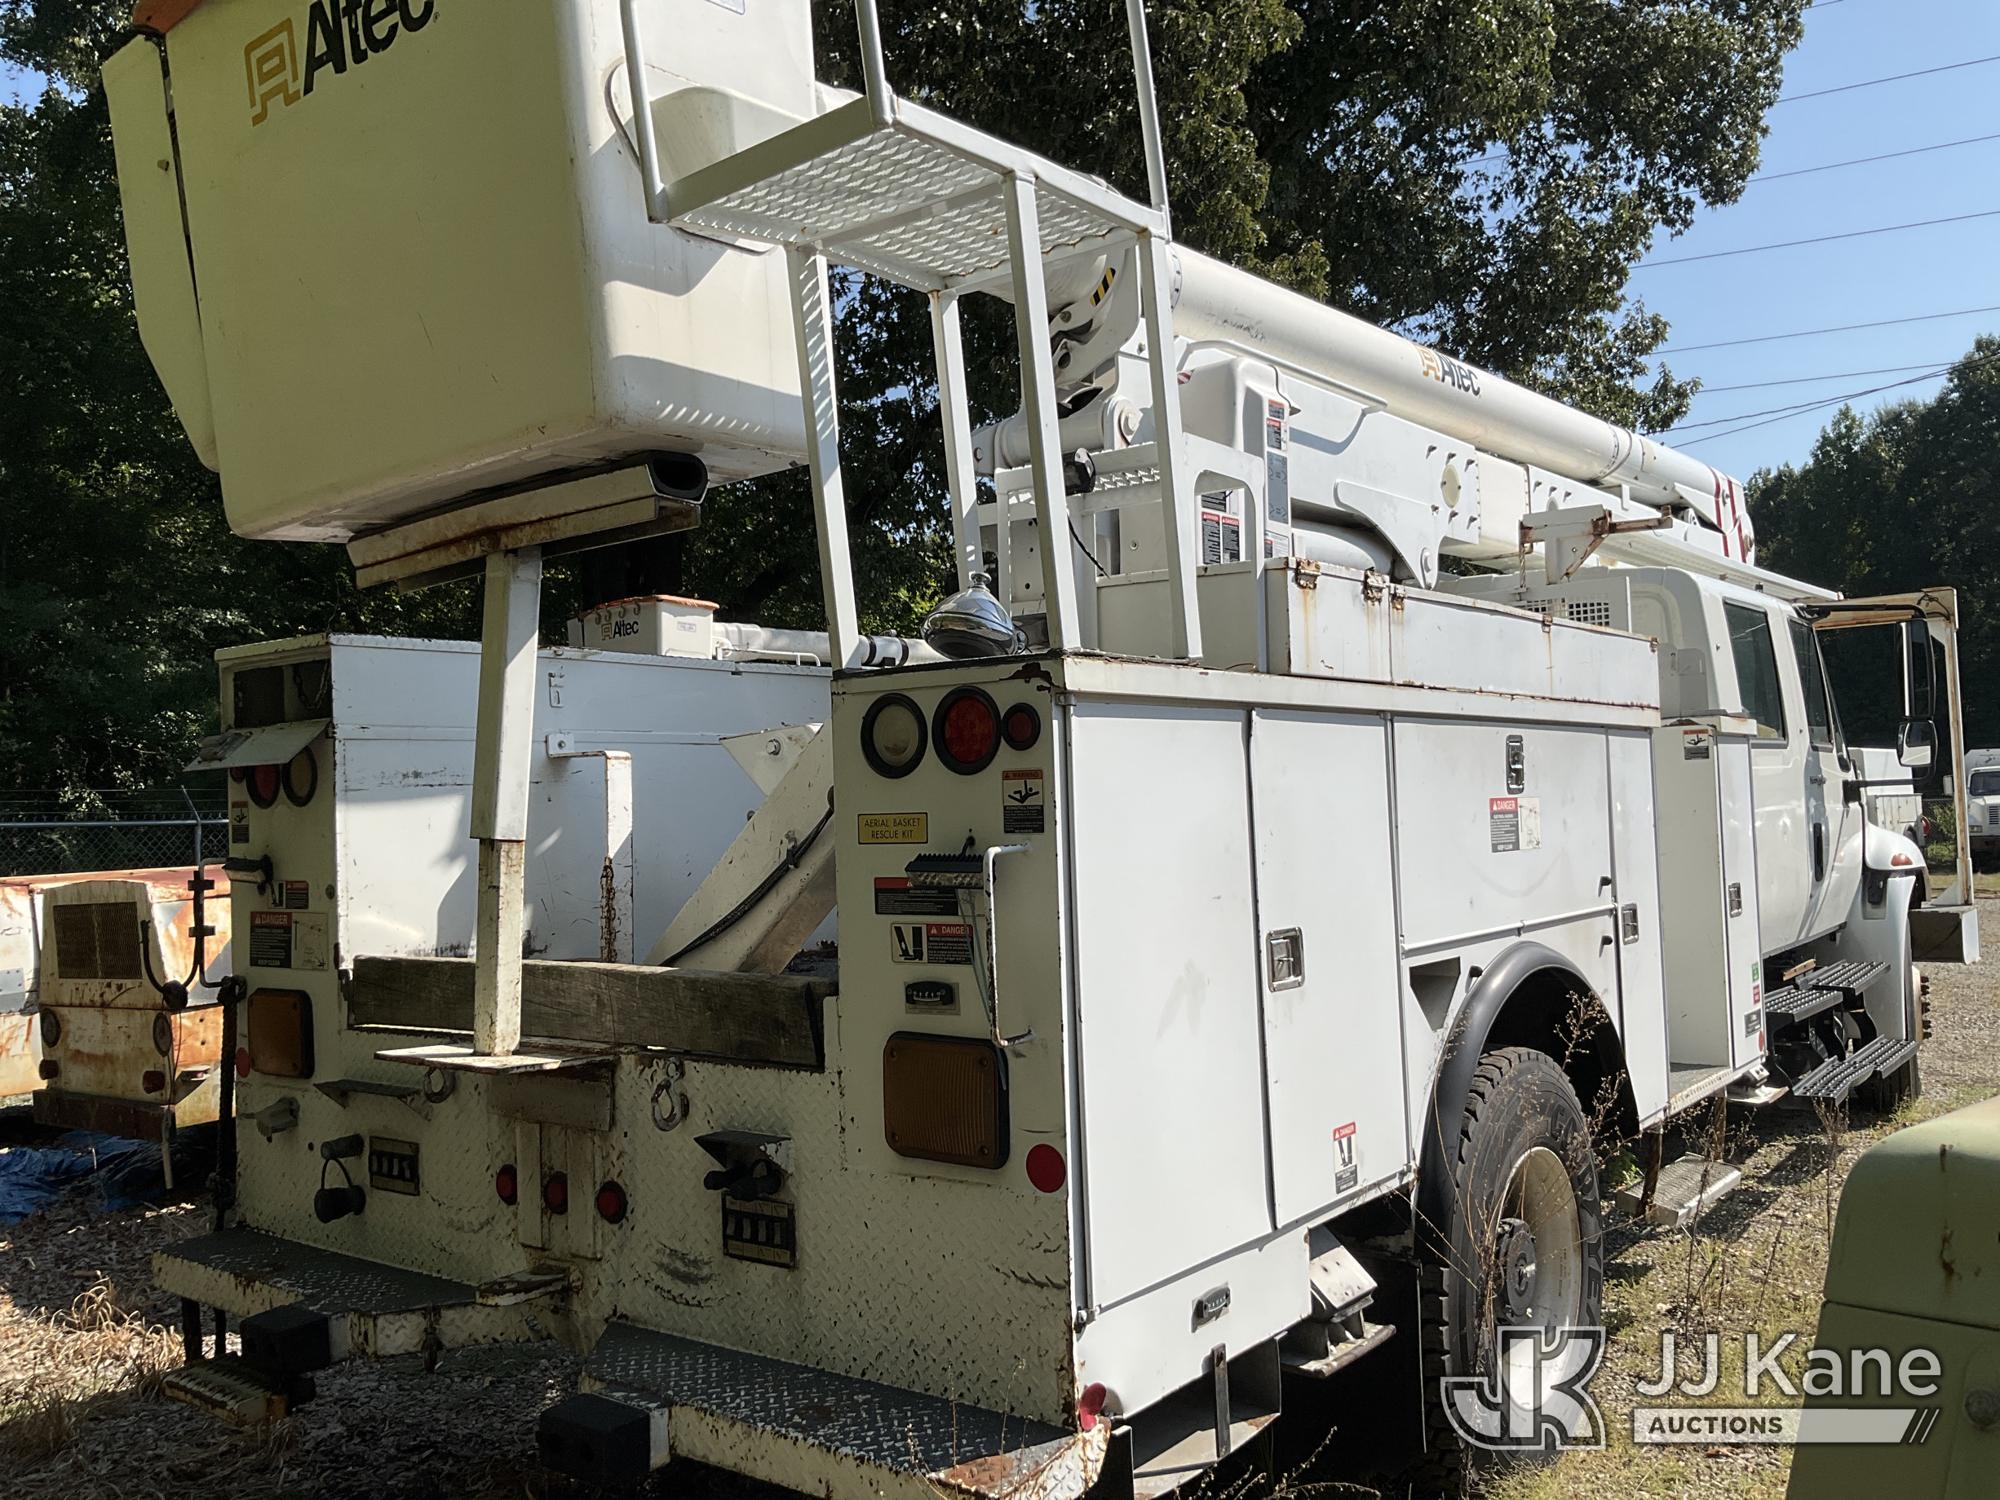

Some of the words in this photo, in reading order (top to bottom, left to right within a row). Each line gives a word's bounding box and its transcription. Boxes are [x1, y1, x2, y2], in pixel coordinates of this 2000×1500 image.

[303, 0, 435, 97] Altec
[1435, 350, 1481, 397] Altec
[613, 620, 639, 638] Altec
[864, 819, 889, 827] AERIAL
[893, 818, 921, 827] BASKET
[871, 830, 899, 839] RESCUE
[902, 829, 914, 838] KIT
[262, 914, 288, 925] DANGER
